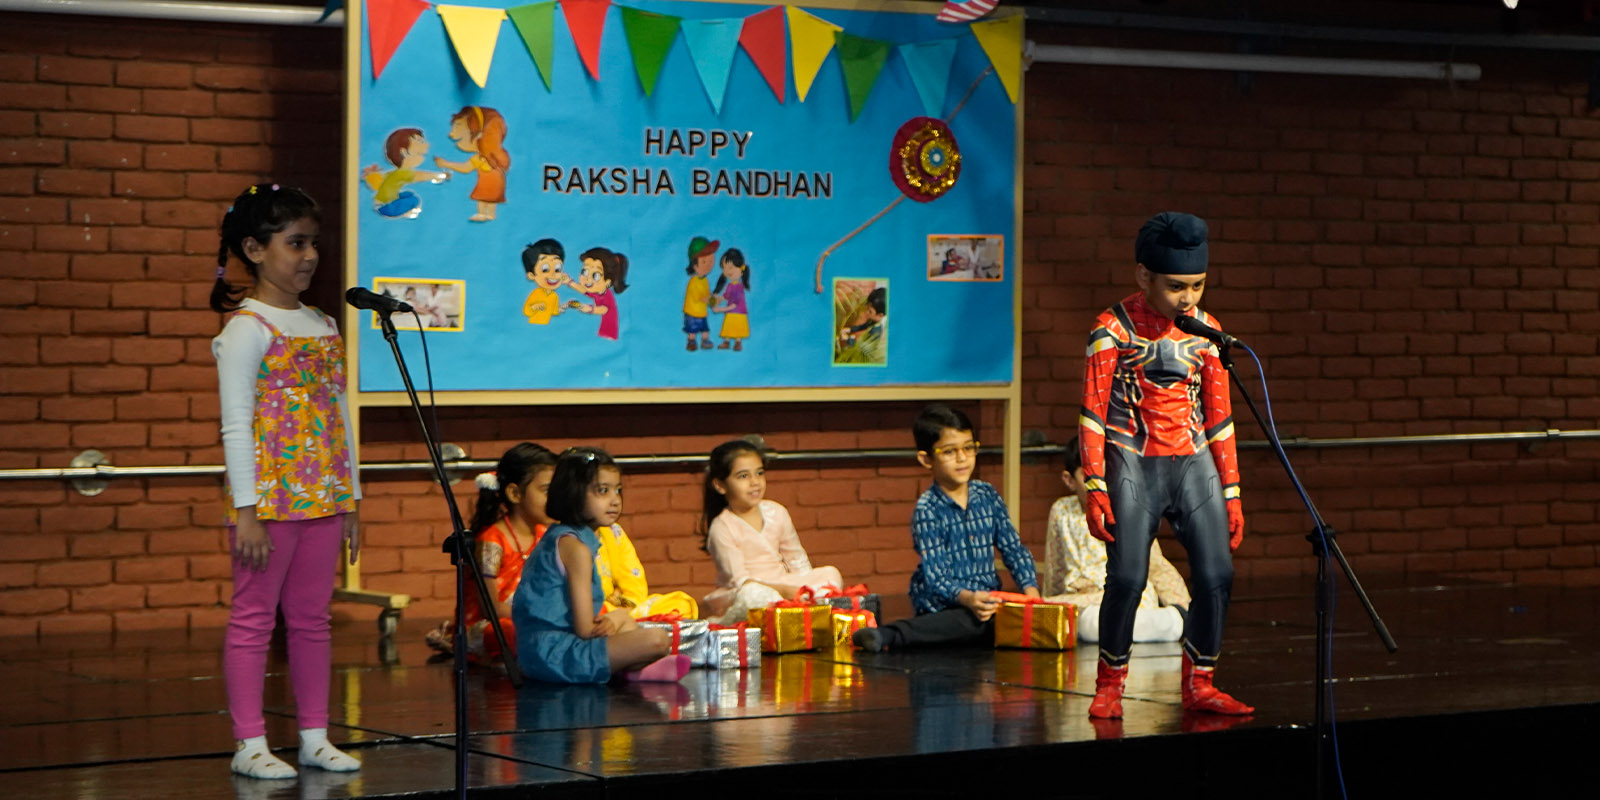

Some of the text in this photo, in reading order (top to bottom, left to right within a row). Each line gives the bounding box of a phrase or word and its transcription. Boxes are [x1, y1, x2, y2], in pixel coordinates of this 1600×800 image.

[645, 128, 752, 158] HAPPY
[543, 164, 832, 198] RAKSHA BANDHAN
